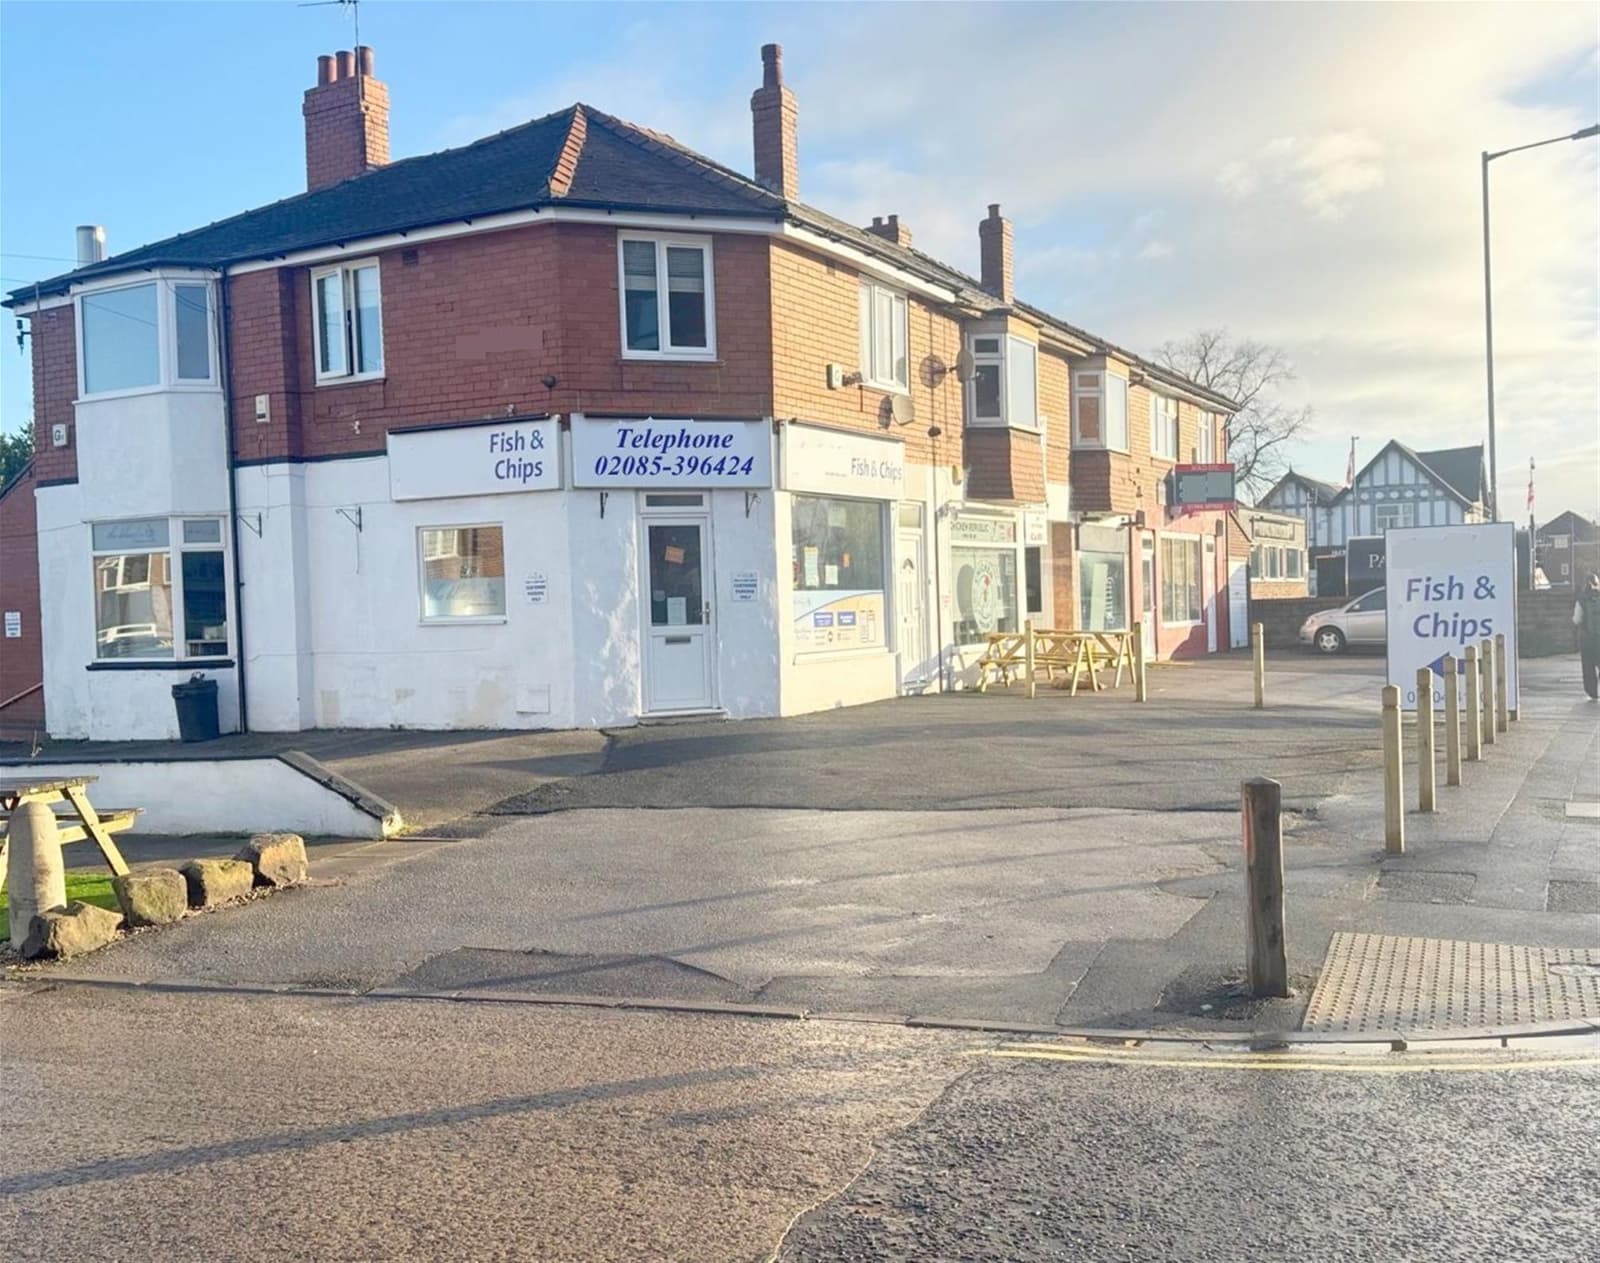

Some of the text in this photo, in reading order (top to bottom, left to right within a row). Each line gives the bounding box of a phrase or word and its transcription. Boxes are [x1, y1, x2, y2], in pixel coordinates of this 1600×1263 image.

[490, 429, 544, 453] Fish &
[616, 428, 734, 454] Telephone
[495, 457, 543, 484] Chips
[594, 455, 755, 476] 02085-396424
[850, 457, 869, 477] Fish
[879, 460, 903, 485] Chips
[1406, 575, 1497, 602] Fish &
[1412, 612, 1494, 645] Chips
